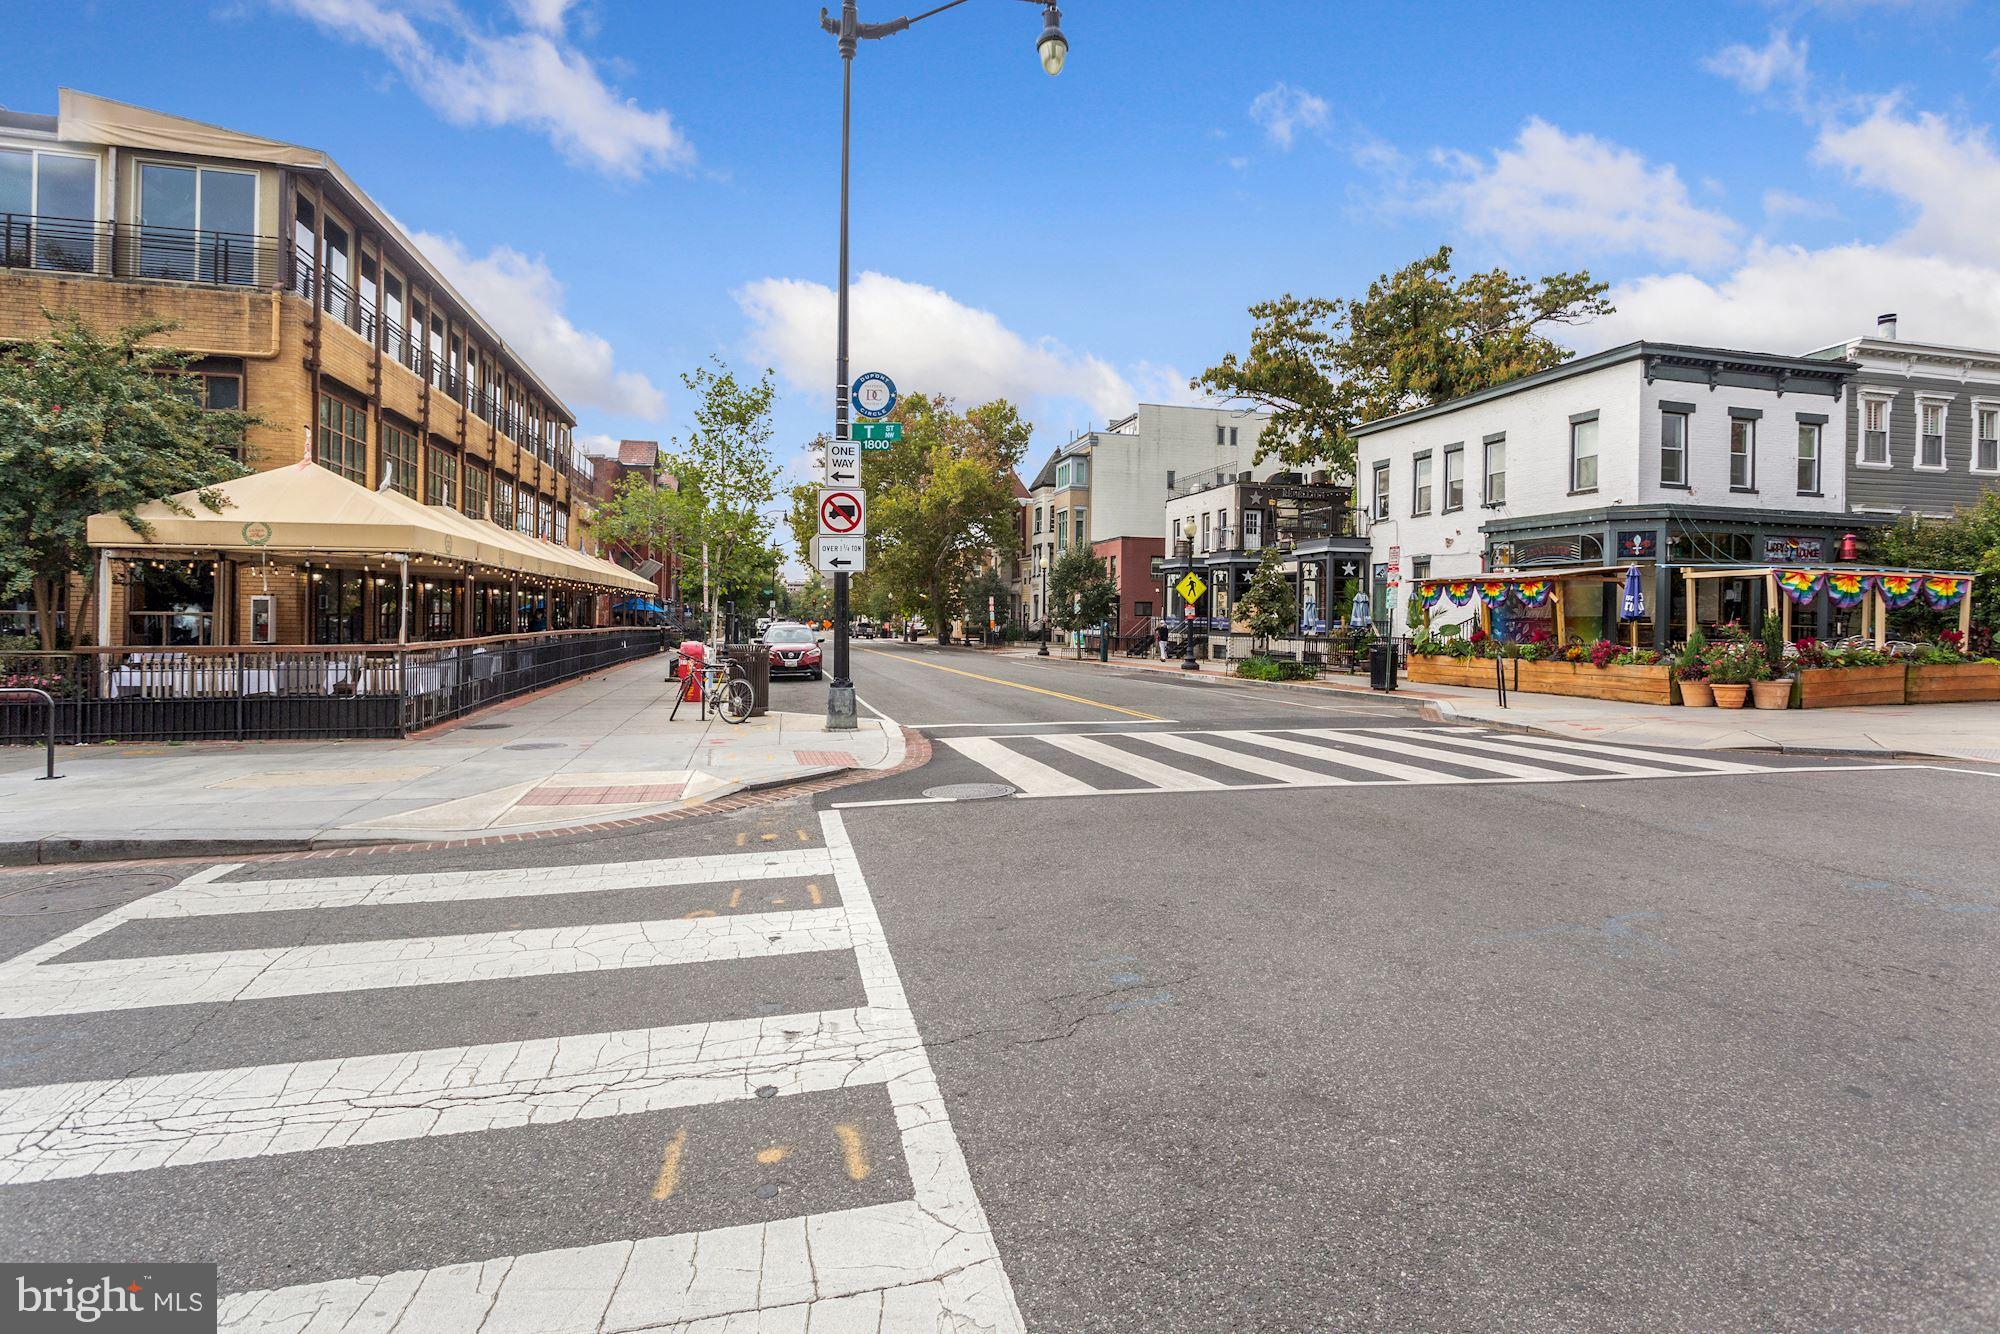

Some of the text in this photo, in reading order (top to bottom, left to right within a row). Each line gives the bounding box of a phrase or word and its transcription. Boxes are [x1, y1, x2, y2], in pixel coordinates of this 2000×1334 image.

[860, 373, 889, 383] DUPONT
[860, 407, 887, 417] CIRCLE
[864, 425, 874, 438] T
[863, 440, 889, 449] 1800
[831, 446, 855, 456] ONE
[832, 459, 855, 468] WAY
